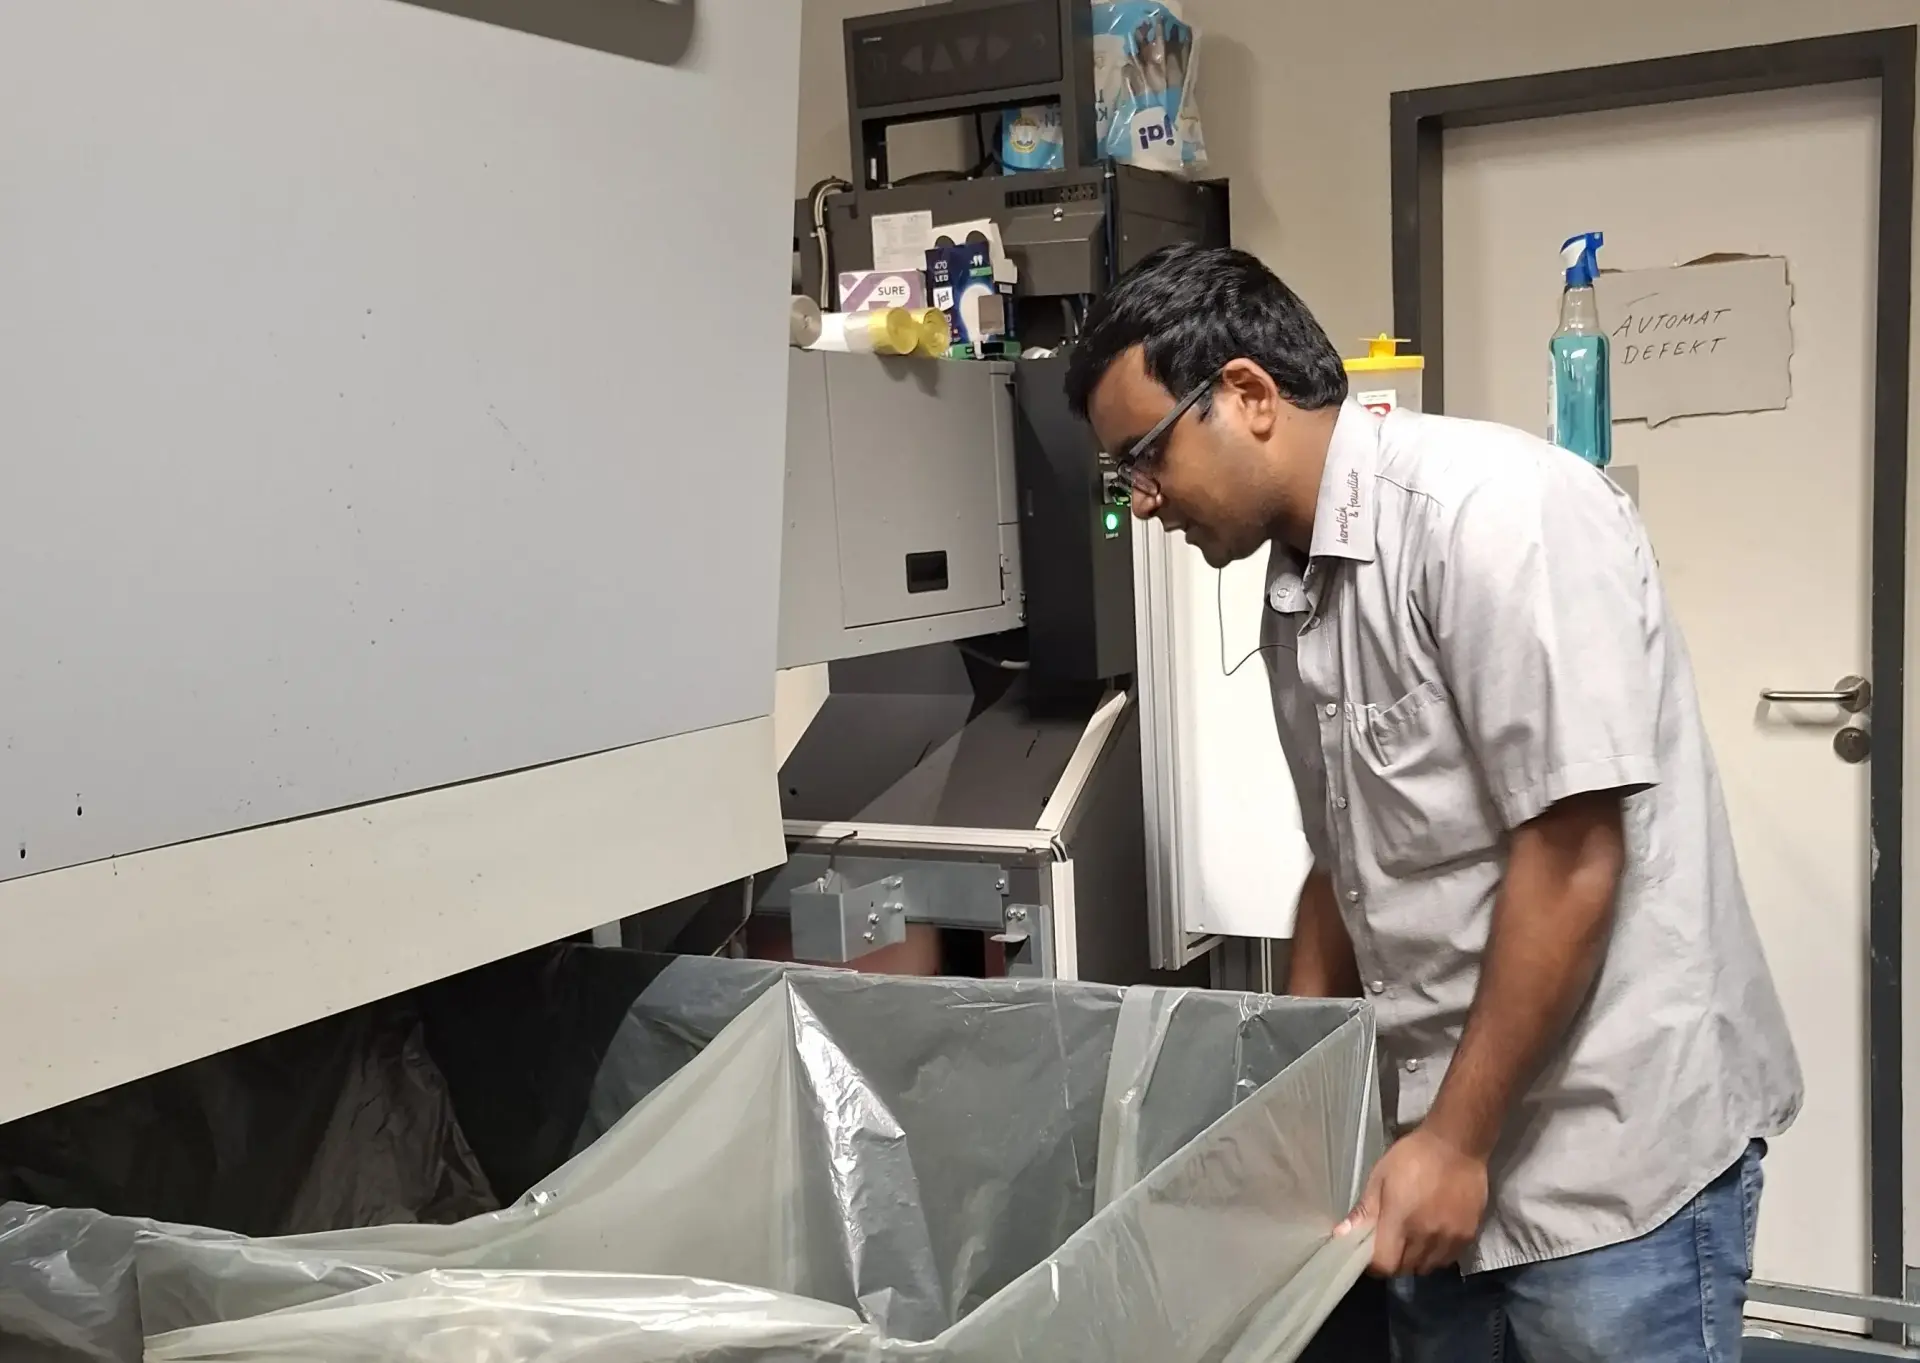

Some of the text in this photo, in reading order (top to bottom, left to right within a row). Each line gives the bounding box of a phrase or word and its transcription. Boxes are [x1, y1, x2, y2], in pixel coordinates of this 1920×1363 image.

[1138, 113, 1175, 150] ja!
[934, 261, 948, 269] 470
[935, 274, 949, 282] LED
[878, 286, 905, 296] SURE
[937, 291, 949, 308] ja!
[1612, 308, 1732, 338] AUTOMAT
[1620, 337, 1727, 365] DEFEKT
